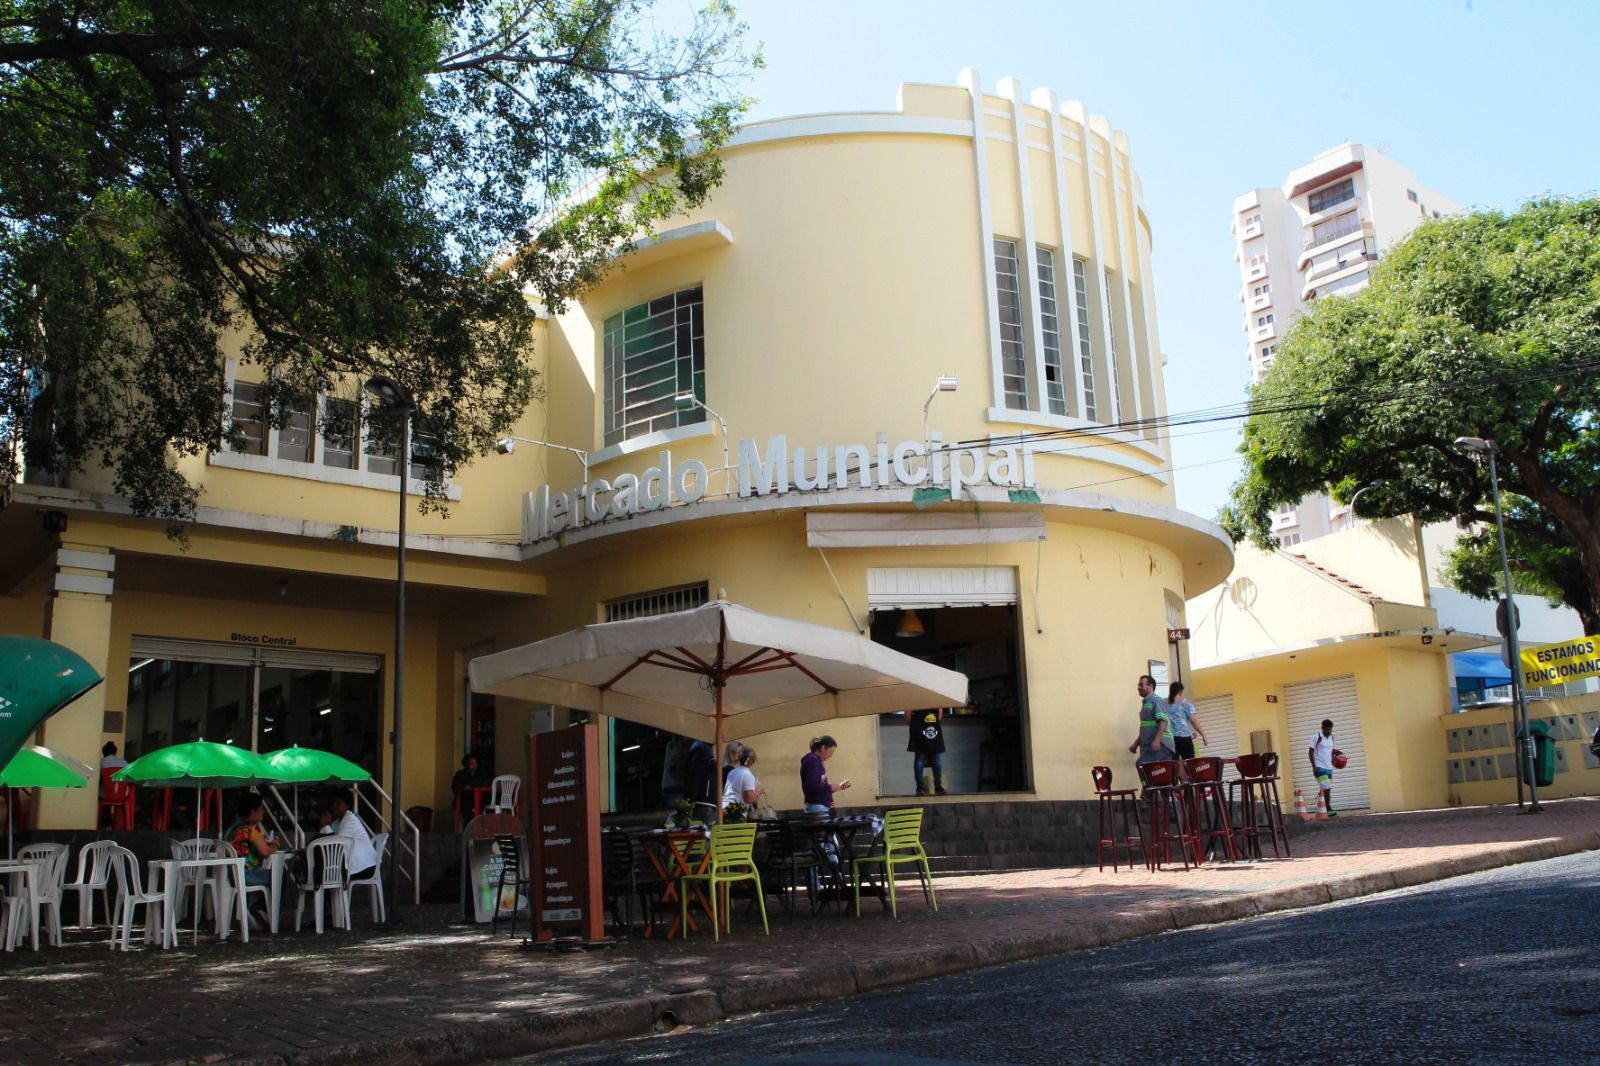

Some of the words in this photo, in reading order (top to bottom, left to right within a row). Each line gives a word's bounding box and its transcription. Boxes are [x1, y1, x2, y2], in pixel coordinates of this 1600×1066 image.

[522, 450, 709, 544] Mercado
[737, 430, 1037, 500] Municipal
[230, 632, 259, 643] Bloco
[261, 634, 297, 646] Central
[1536, 641, 1594, 663] ESTAMOS
